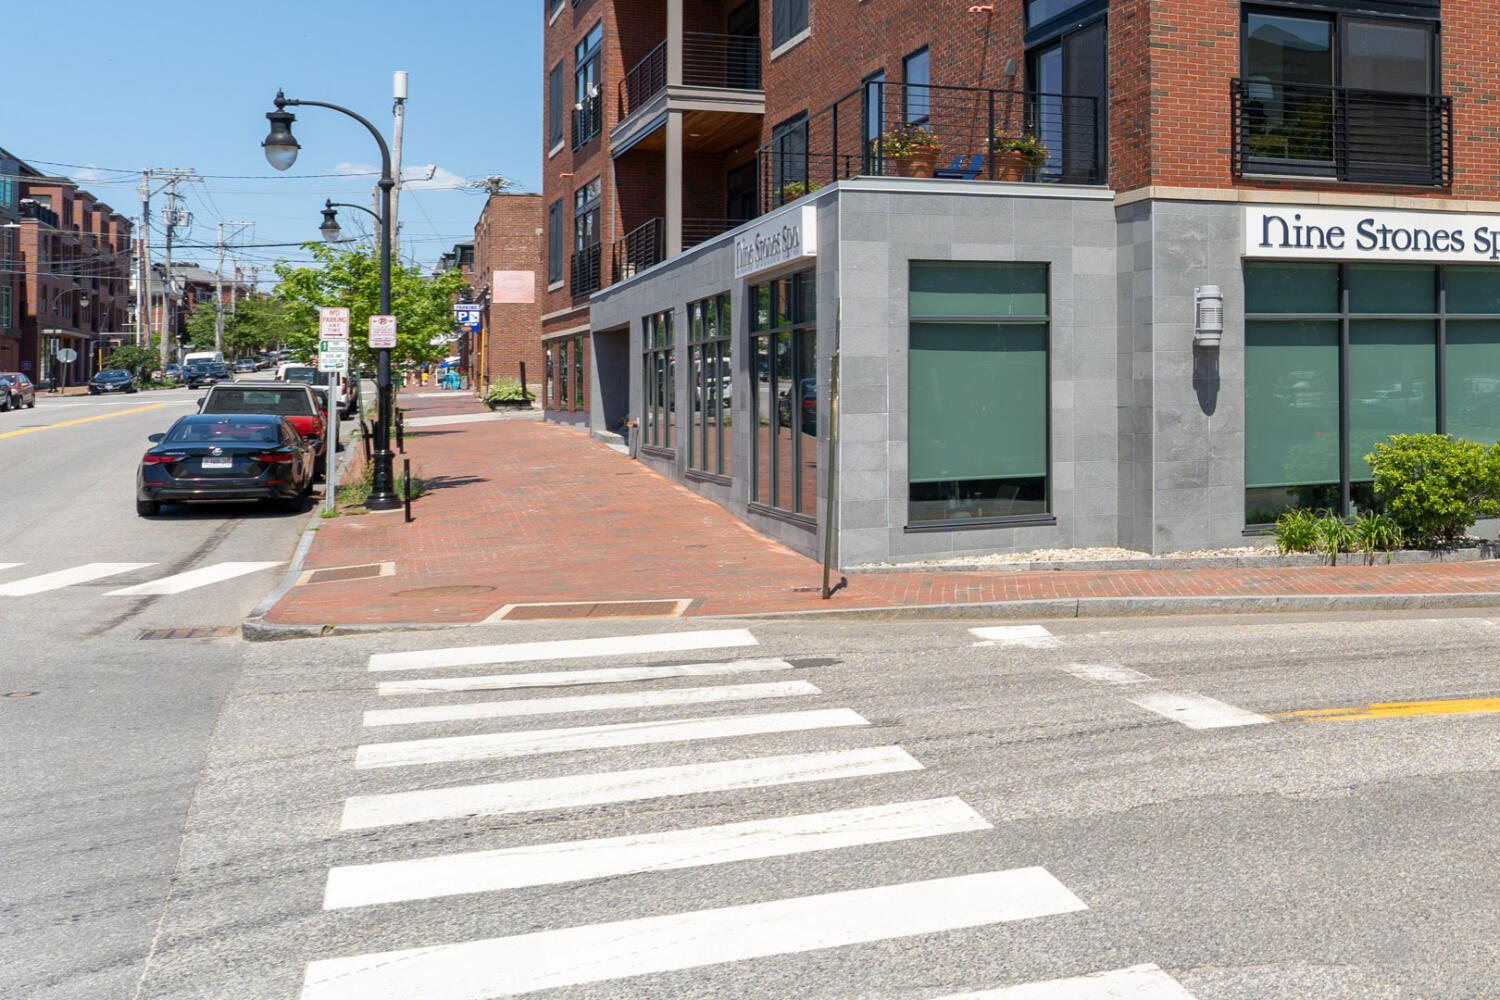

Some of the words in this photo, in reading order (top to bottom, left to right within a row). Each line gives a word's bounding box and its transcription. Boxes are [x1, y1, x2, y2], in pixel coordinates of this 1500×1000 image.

[782, 224, 800, 258] Spa
[1259, 213, 1345, 249] Nine
[1356, 217, 1465, 252] Stones
[458, 311, 468, 321] P
